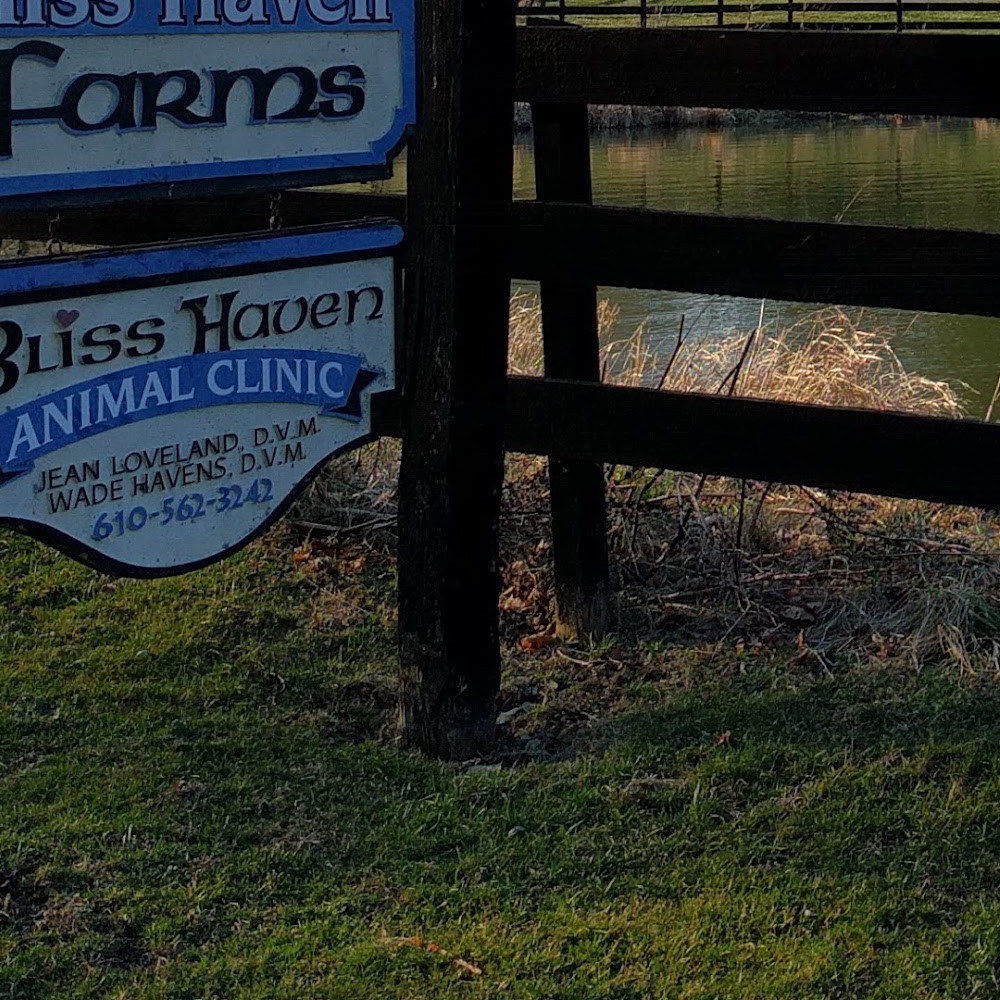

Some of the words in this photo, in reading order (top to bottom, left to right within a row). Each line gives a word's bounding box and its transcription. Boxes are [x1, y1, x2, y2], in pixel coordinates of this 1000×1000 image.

[0, 41, 366, 158] Farms
[180, 286, 384, 353] Haven
[6, 366, 195, 463] ANIMAL
[207, 358, 346, 398] CLINIC
[36, 460, 100, 493] JEAN
[111, 433, 245, 476] LOVELAND,
[253, 417, 321, 447] D.V.M.
[49, 479, 124, 514] WADE
[132, 455, 233, 497] HAVENS,
[91, 478, 274, 541] 610-562-3242
